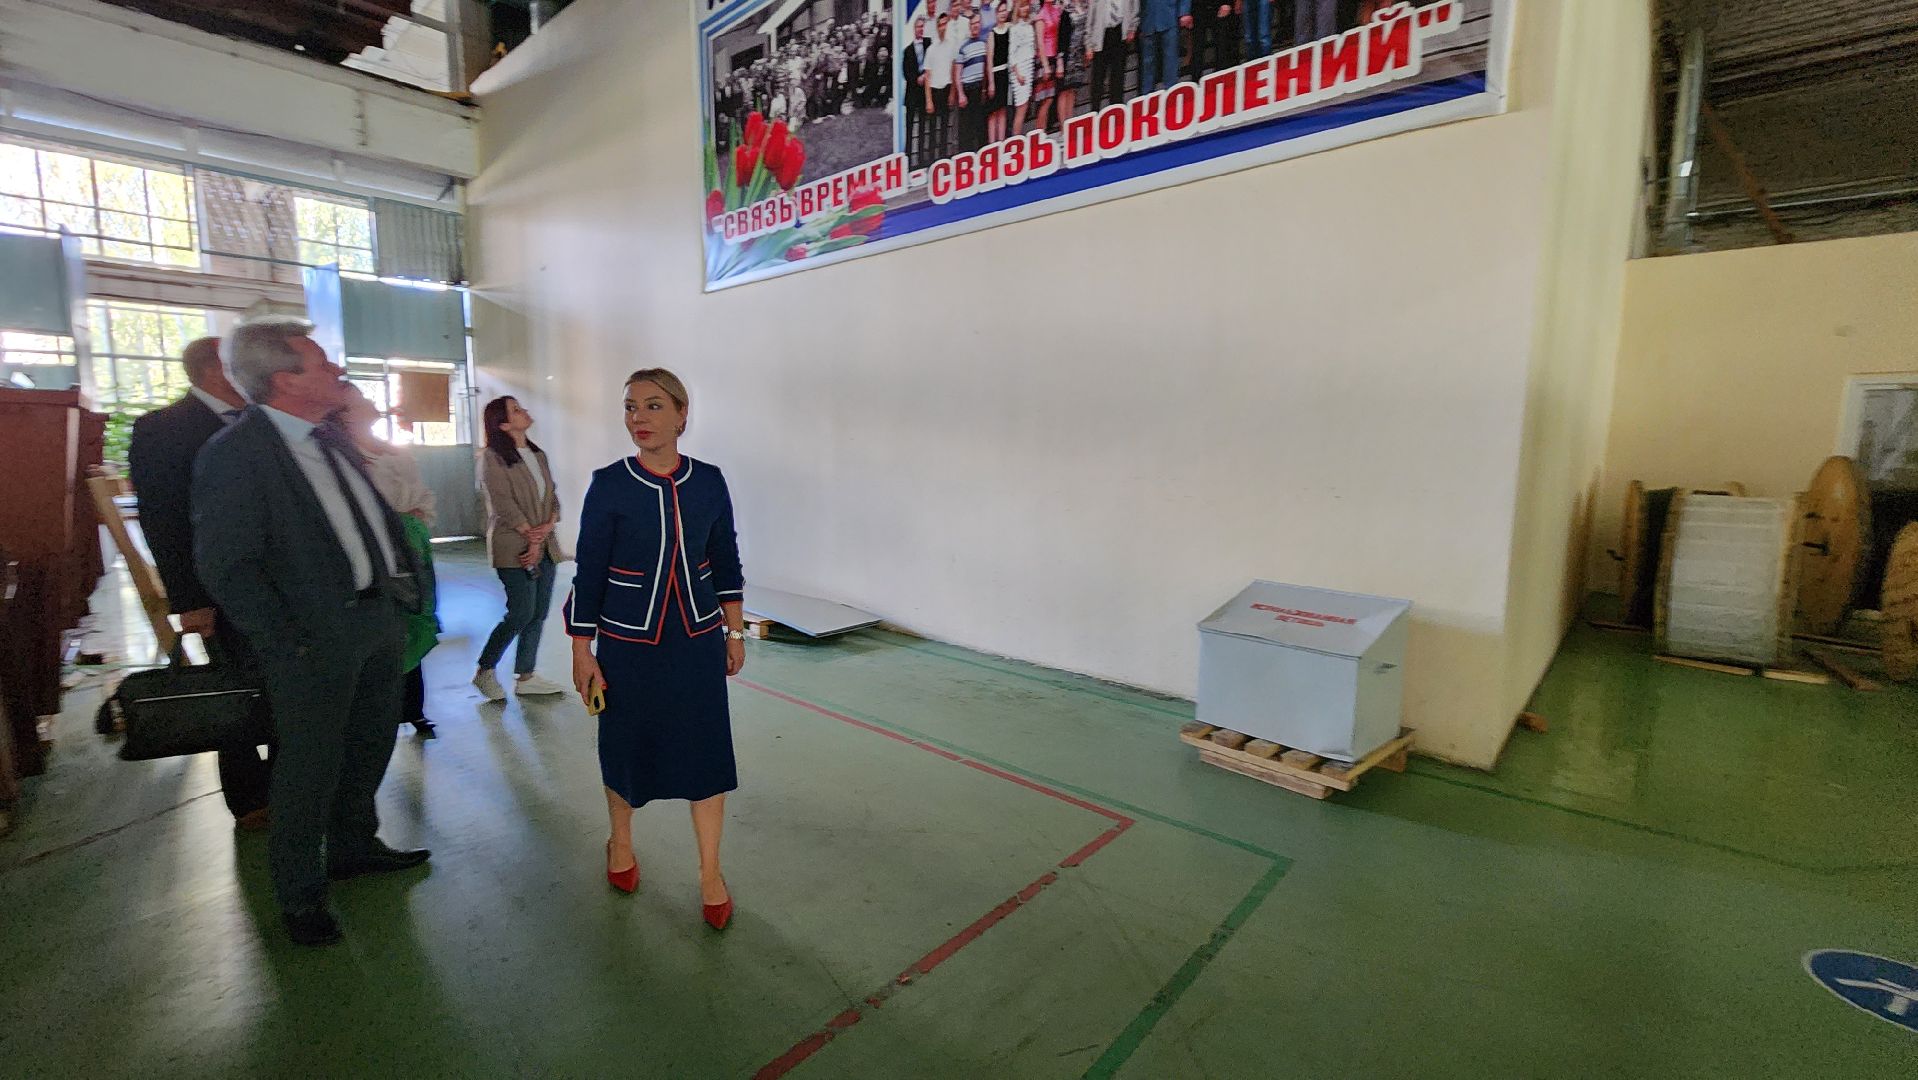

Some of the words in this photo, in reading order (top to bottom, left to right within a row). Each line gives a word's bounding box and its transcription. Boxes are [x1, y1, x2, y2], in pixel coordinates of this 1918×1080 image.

[800, 157, 903, 217] ВРЕМЕН
[932, 133, 1053, 198] СВЯЗЬ
[1067, 3, 1452, 160] ПОКОЛЕНИЙ"
